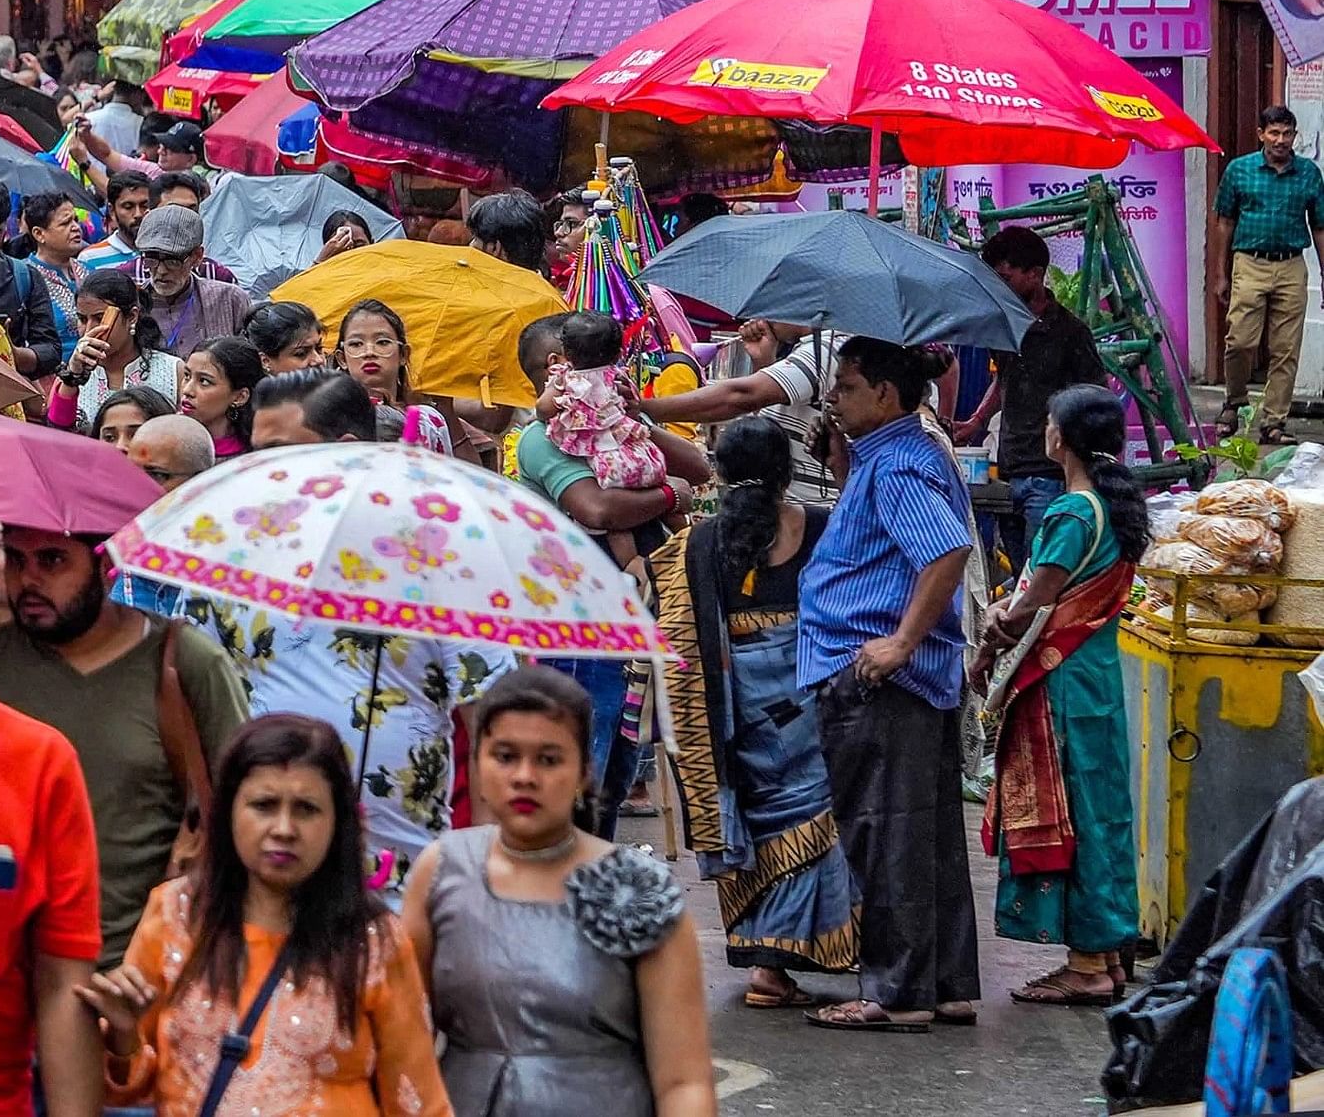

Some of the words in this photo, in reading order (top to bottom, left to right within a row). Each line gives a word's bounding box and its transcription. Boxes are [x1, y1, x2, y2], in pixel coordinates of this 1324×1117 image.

[1074, 21, 1202, 50] ACID
[727, 66, 818, 89] baazar
[909, 61, 927, 81] 8
[933, 63, 1018, 90] States
[957, 86, 1044, 109] Stores
